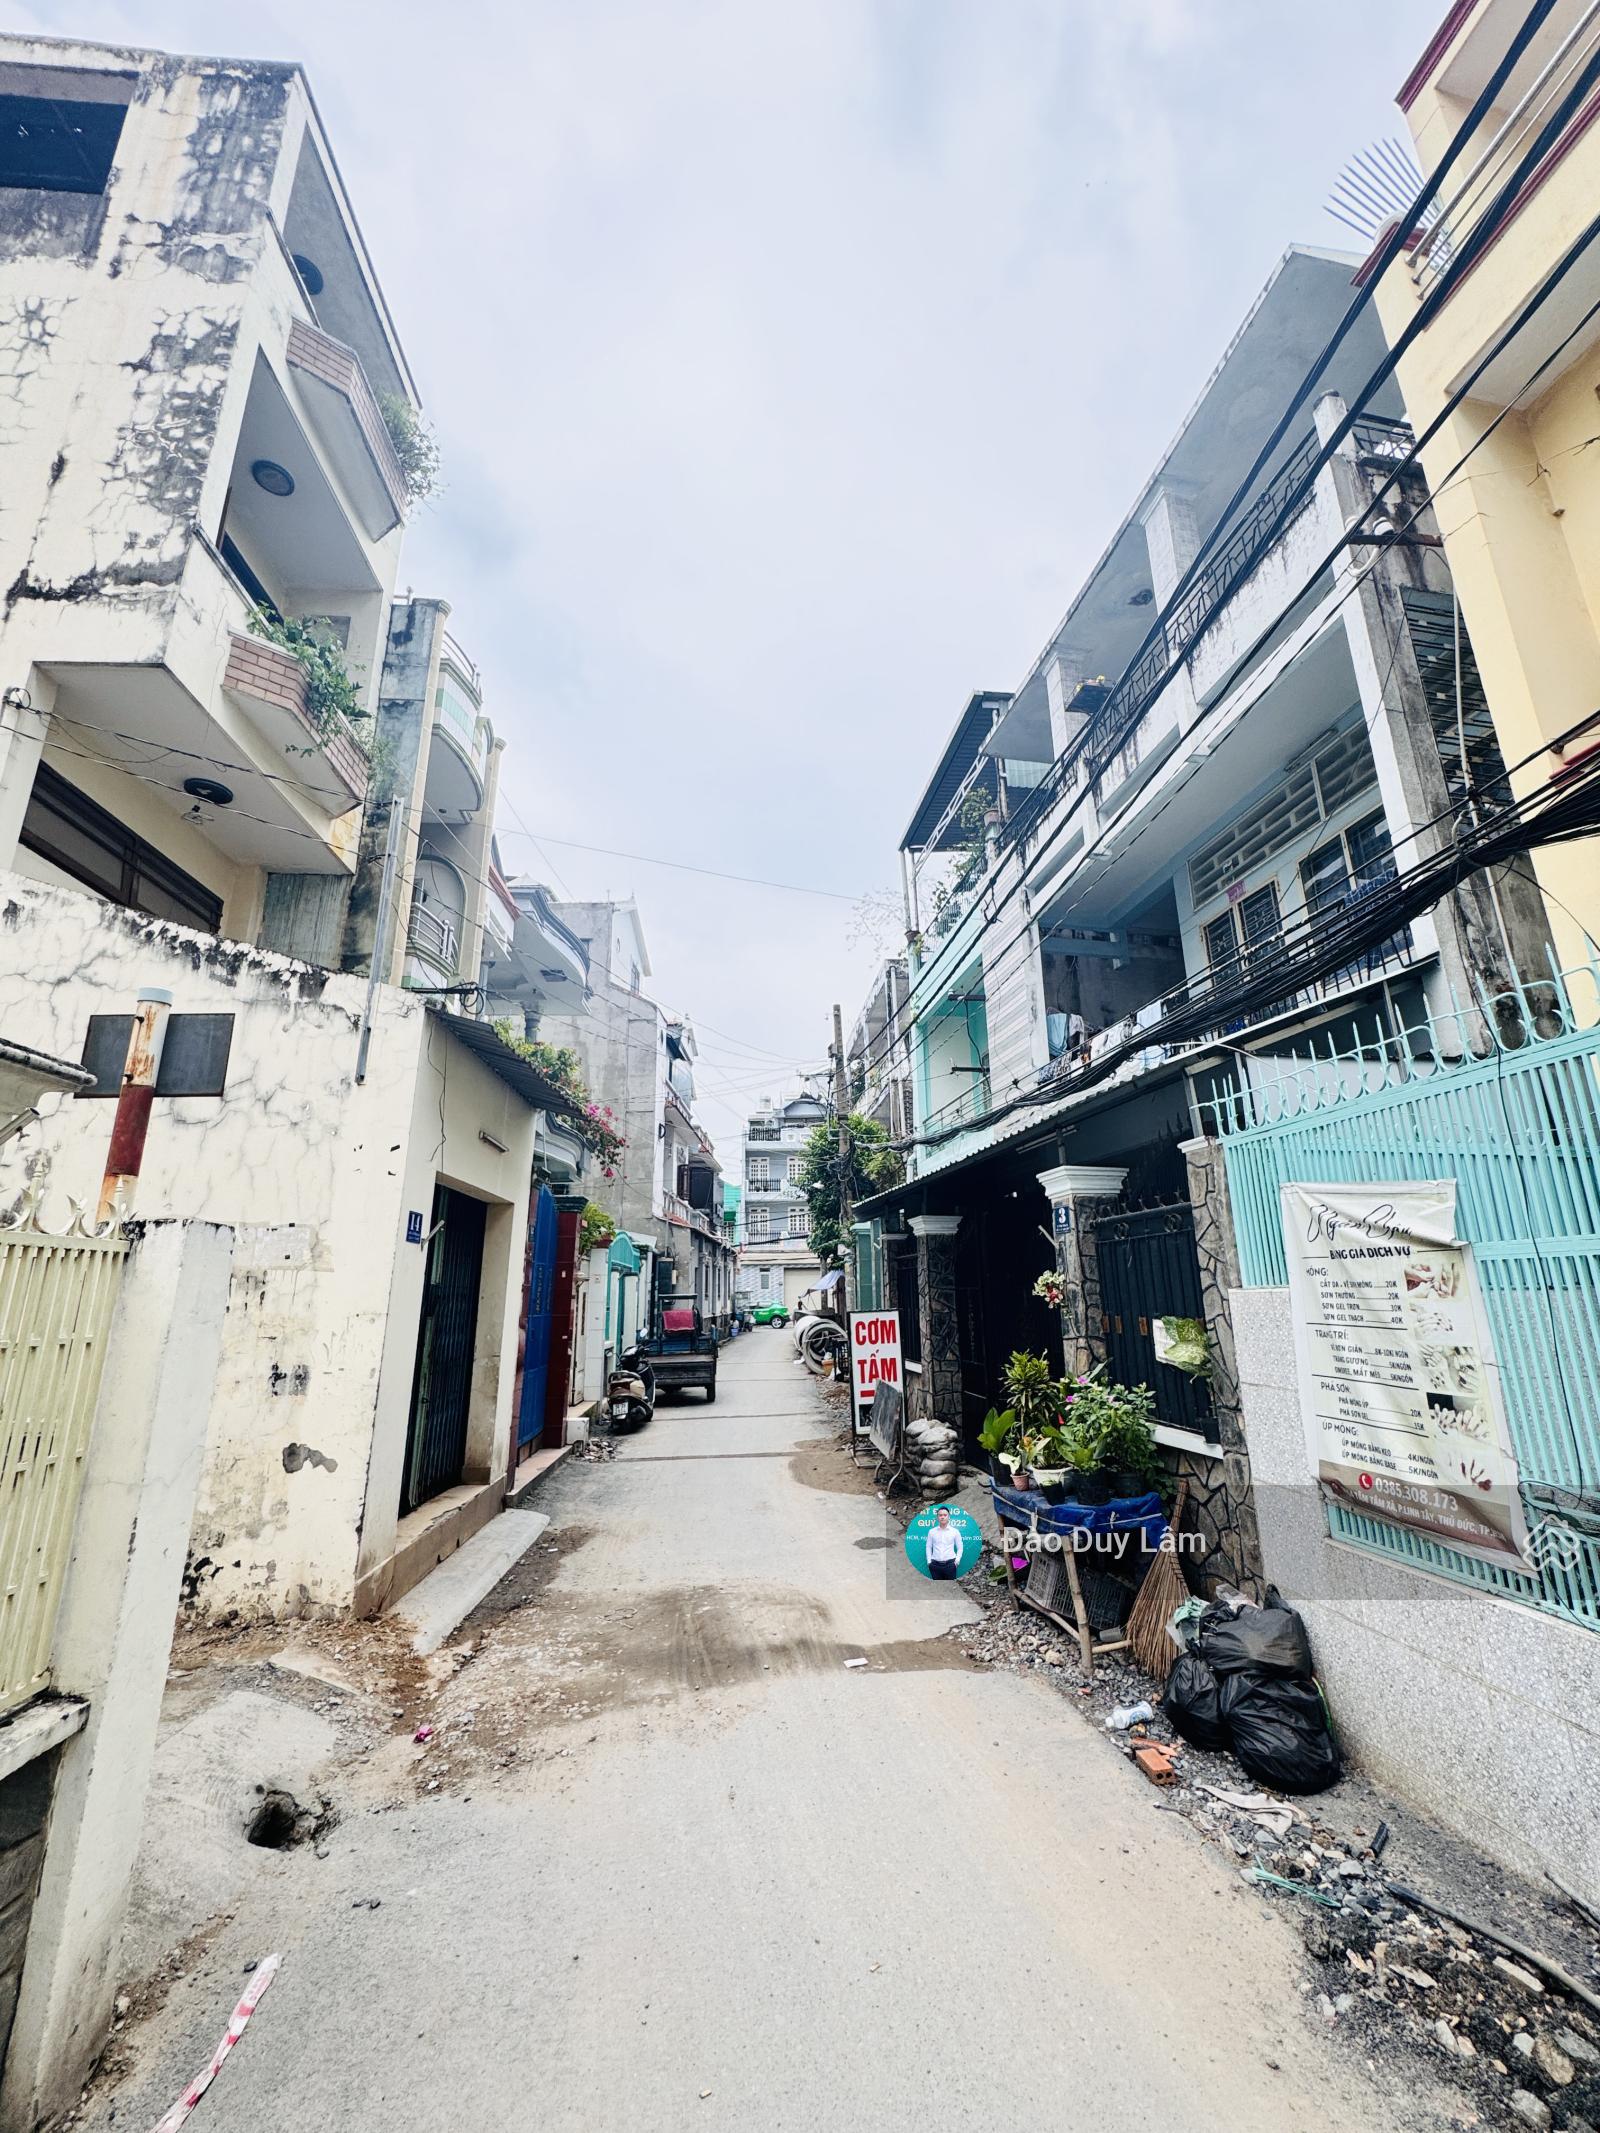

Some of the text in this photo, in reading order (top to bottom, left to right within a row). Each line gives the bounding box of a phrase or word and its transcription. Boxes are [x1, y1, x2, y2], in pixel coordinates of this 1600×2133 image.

[1058, 1207, 1066, 1223] 3
[1366, 1246, 1393, 1260] DỊCH
[855, 1317, 896, 1345] CƠM
[857, 1349, 897, 1384] TẤM
[1375, 1478, 1458, 1512] 0385.308.173
